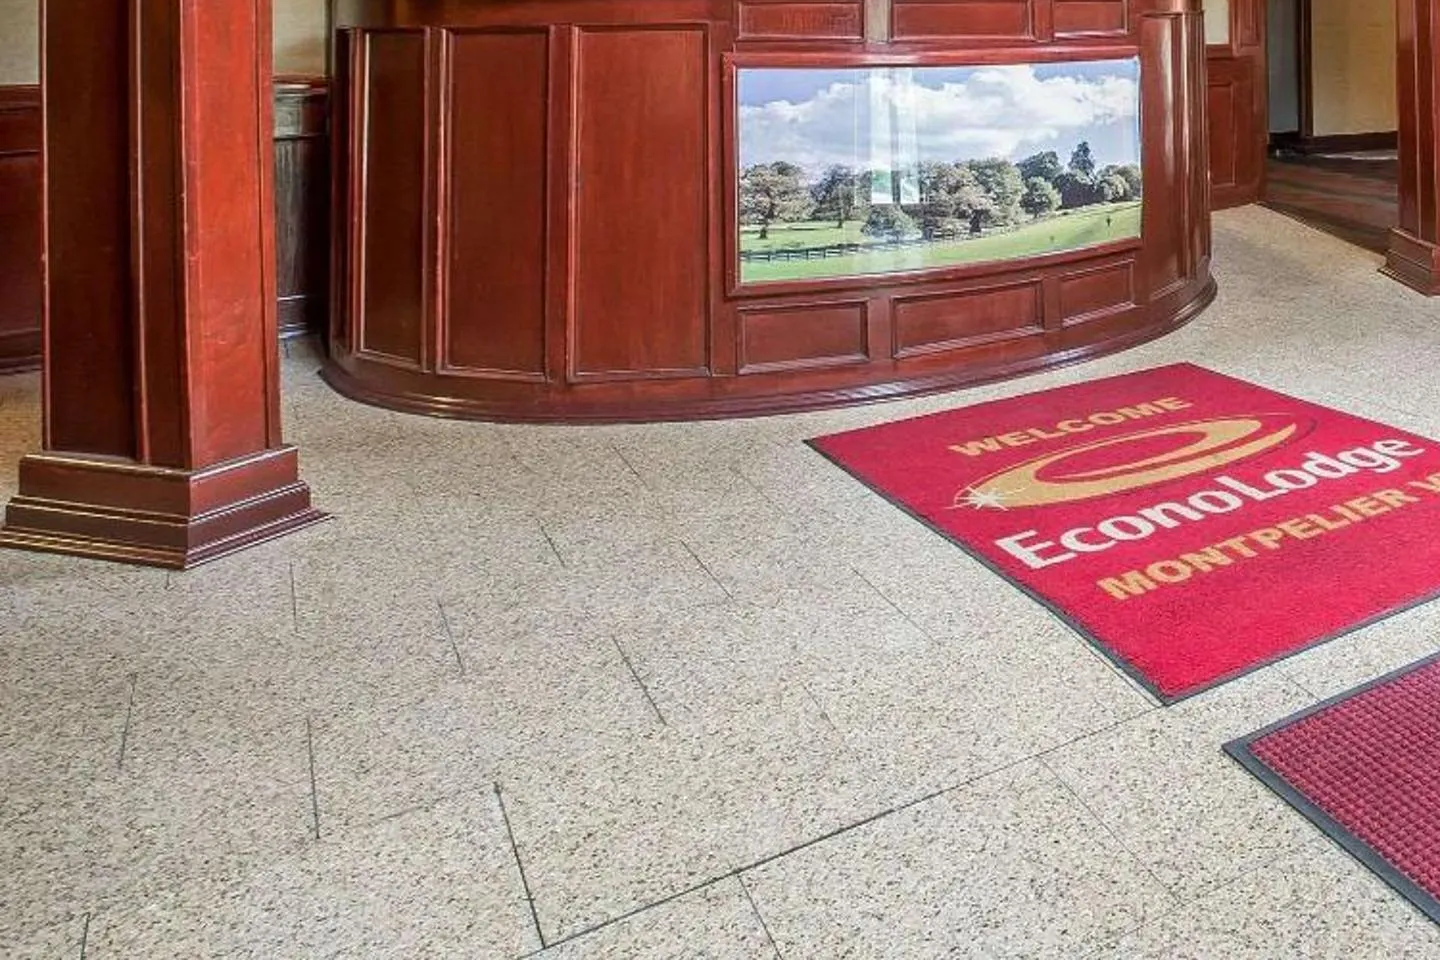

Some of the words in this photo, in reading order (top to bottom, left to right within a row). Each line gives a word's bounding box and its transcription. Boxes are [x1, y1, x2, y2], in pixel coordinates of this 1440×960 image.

[948, 396, 1194, 458] WELCOME
[995, 439, 1426, 570] EconoLodge
[1096, 488, 1422, 601] MONTPELIER
